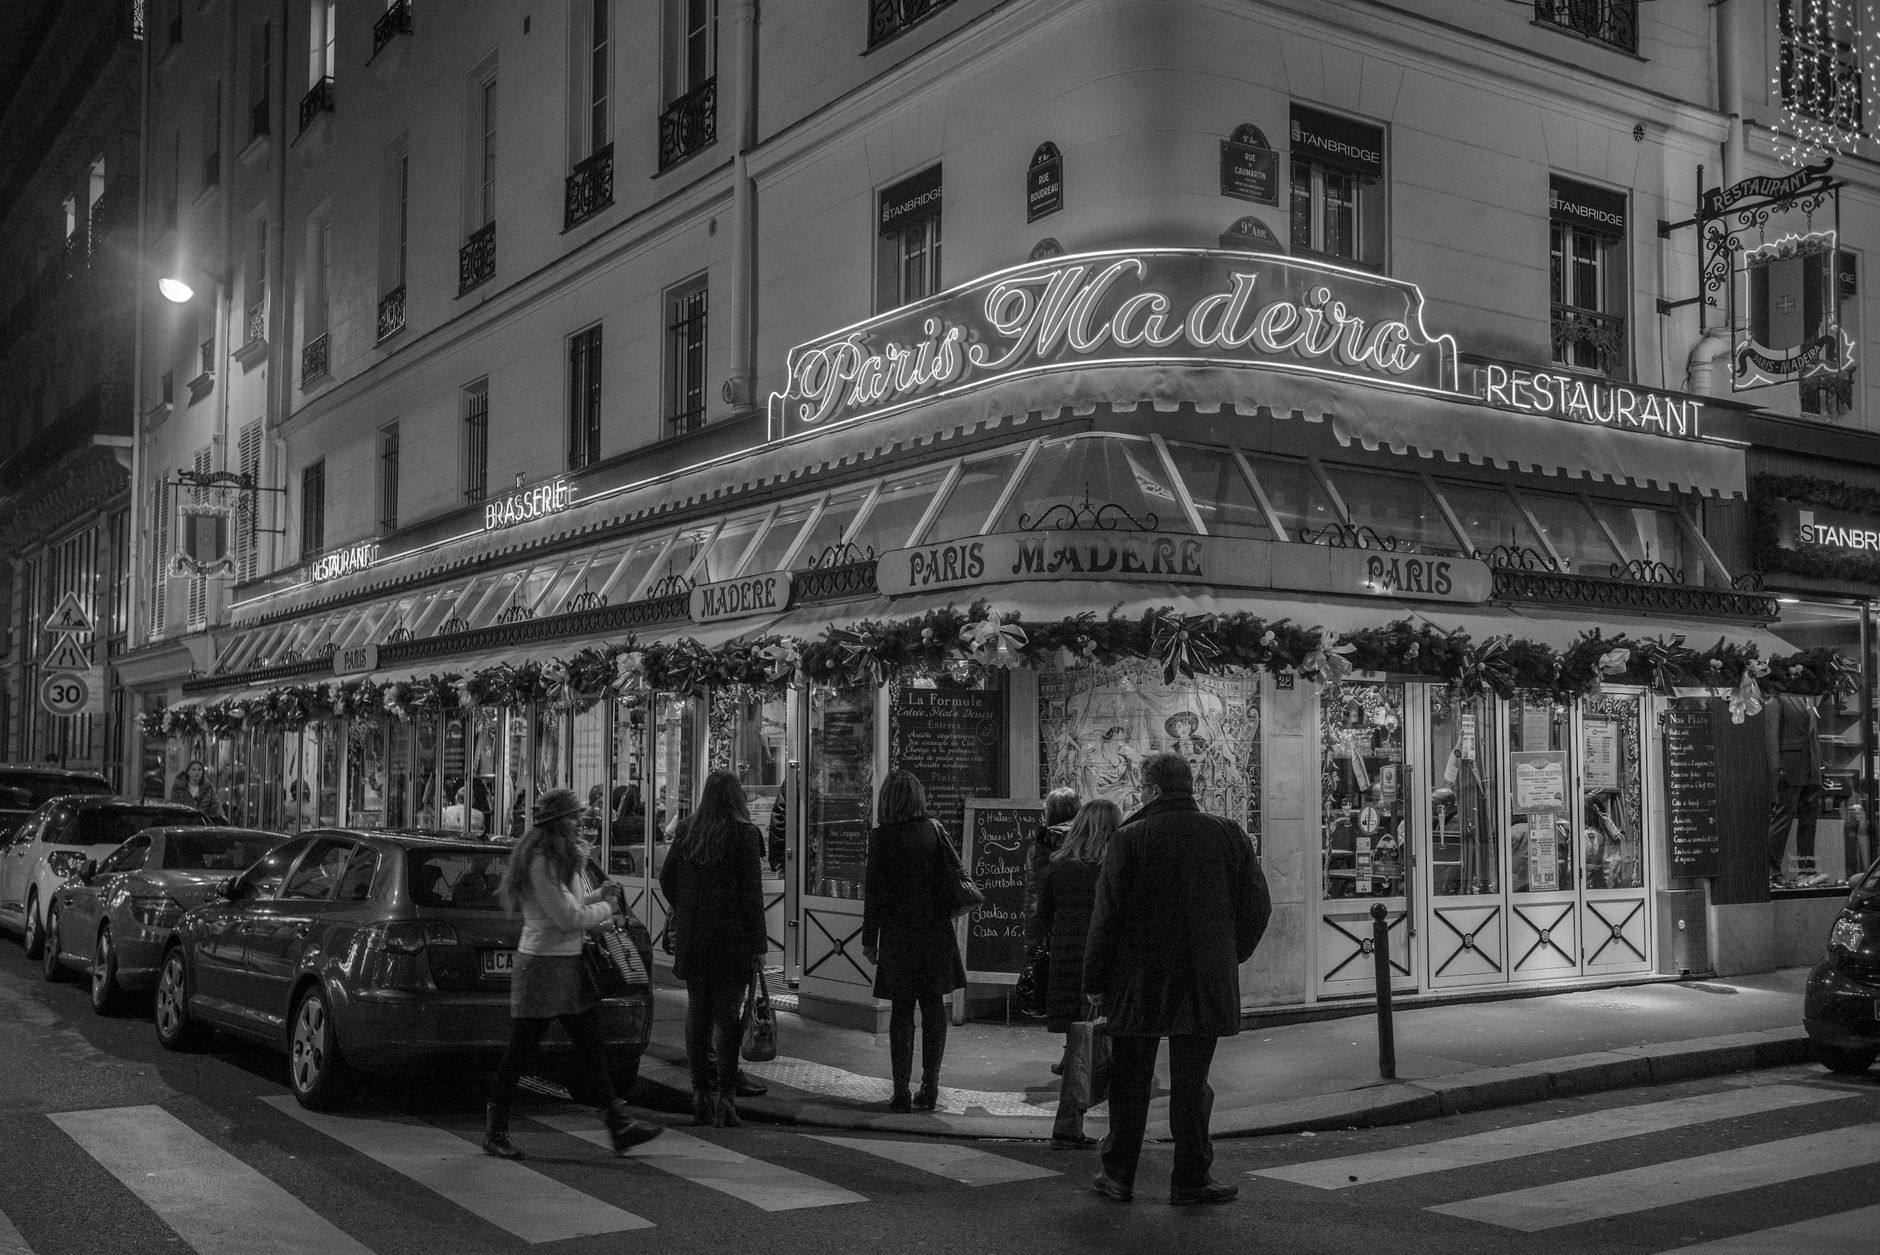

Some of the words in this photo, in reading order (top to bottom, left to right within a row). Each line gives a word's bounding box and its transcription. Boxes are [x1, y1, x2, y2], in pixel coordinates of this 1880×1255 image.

[1244, 152, 1256, 162] RUE
[1291, 130, 1380, 164] STANBRIDGE
[1038, 172, 1050, 185] RUE
[1234, 165, 1266, 180] CAUMARTIN
[1030, 182, 1059, 203] BOUDREAU
[1712, 171, 1809, 211] RESTAURANT
[1550, 198, 1624, 227] STANBRIDGE
[799, 318, 962, 423] Paris
[969, 257, 1420, 372] Madeira
[1487, 364, 1705, 438] RESTAURANT
[486, 480, 570, 530] BRASSERIE
[310, 546, 373, 582] RESTAURANT
[909, 542, 985, 587] PARIS
[1011, 537, 1203, 576] MADERE
[1366, 555, 1452, 596] PARIS
[701, 577, 776, 618] MADERE
[344, 648, 367, 670] PARIS
[1278, 675, 1293, 688] 28
[51, 685, 80, 703] 30
[909, 692, 923, 705] La
[930, 693, 983, 707] Formule
[961, 708, 994, 719] Dessert
[1670, 713, 1685, 724] Nos
[1687, 714, 1708, 724] Plats
[931, 771, 957, 782] Plats
[978, 811, 985, 826] 6
[975, 856, 1020, 881] Escalope
[973, 925, 999, 937] Casa
